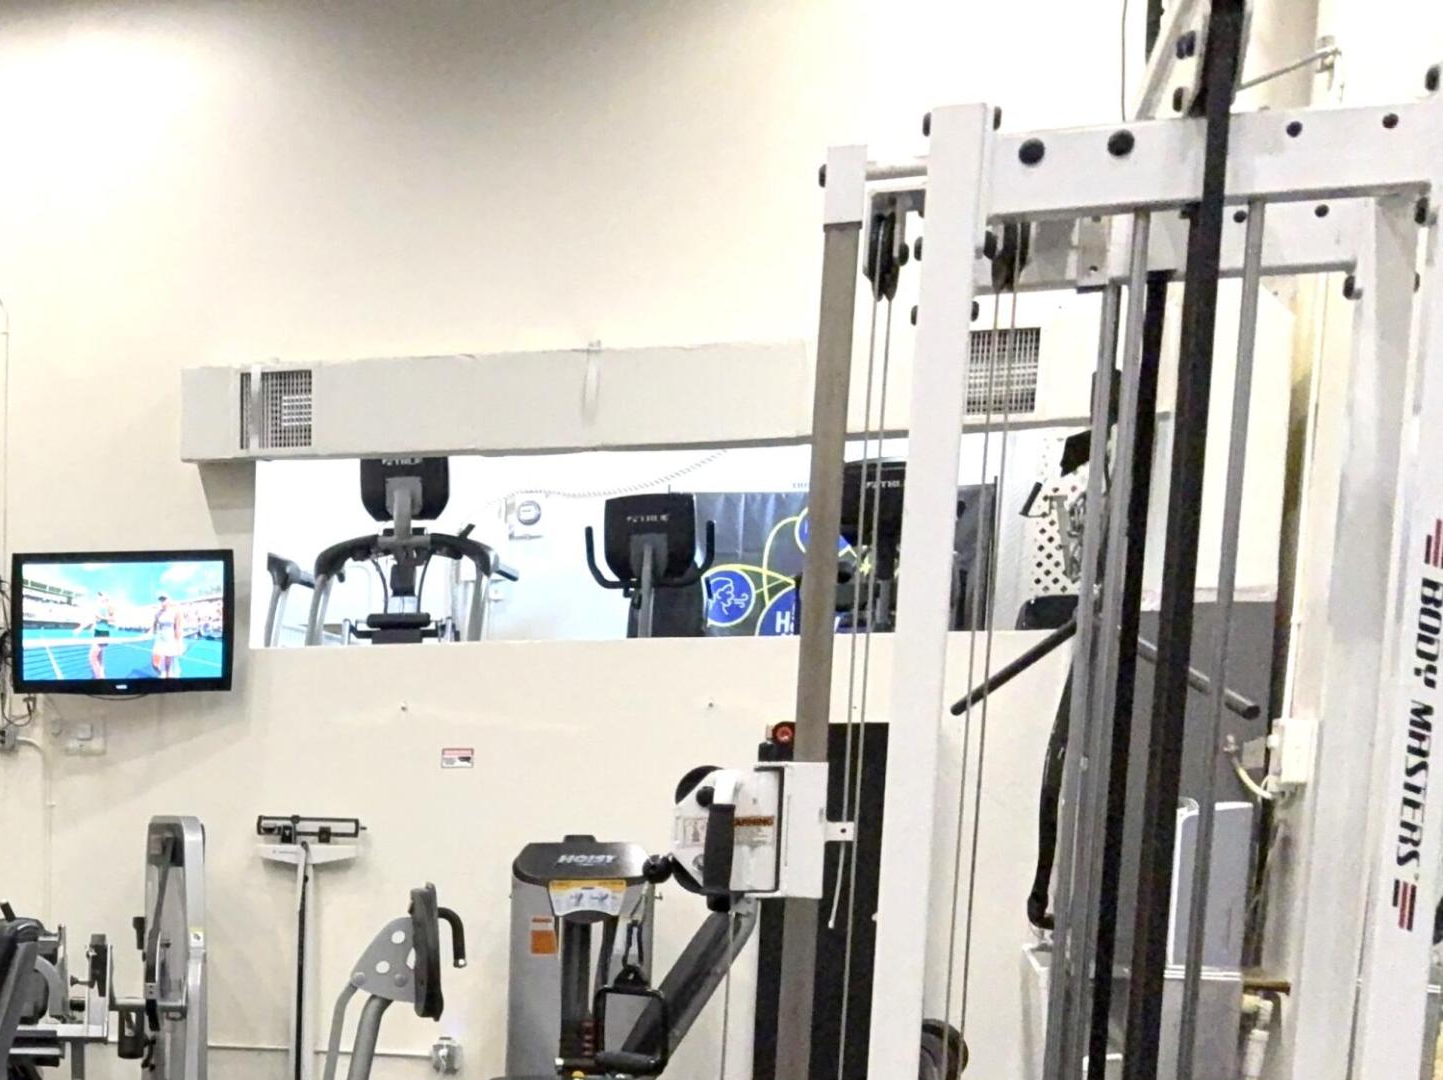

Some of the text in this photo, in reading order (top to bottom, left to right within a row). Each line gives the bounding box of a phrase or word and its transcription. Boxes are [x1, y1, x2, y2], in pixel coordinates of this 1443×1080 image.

[1397, 578, 1443, 867] BODY MASTERS
[733, 816, 774, 827] ARNING
